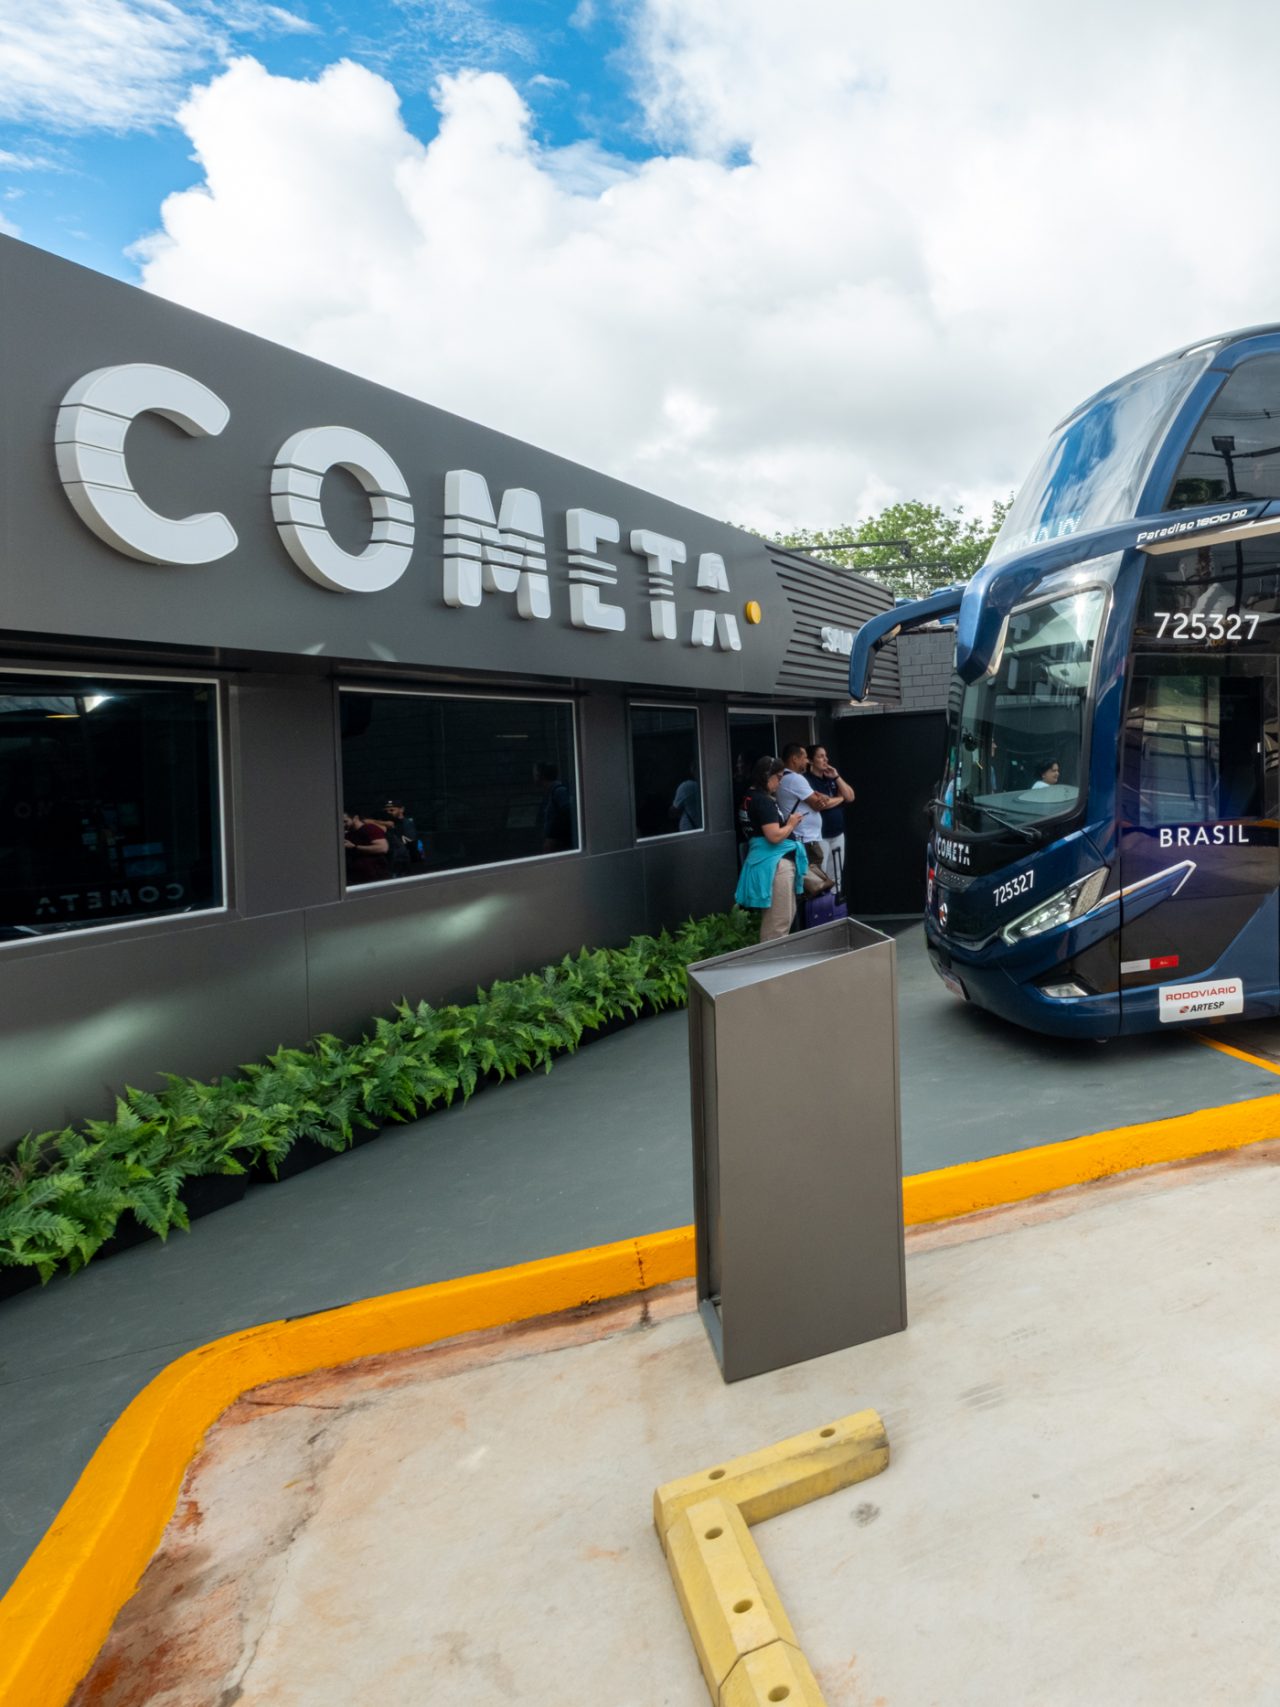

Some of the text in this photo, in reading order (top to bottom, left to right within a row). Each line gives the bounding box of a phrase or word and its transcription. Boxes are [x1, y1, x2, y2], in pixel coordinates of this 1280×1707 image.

[54, 363, 743, 652] COMETA
[1136, 508, 1248, 543] Paradiso 1800 DD
[1154, 612, 1260, 640] 725327
[936, 836, 970, 866] COMETA
[1160, 824, 1249, 848] BRASIL
[992, 869, 1034, 907] 725327
[1189, 1001, 1225, 1013] ARTESP
